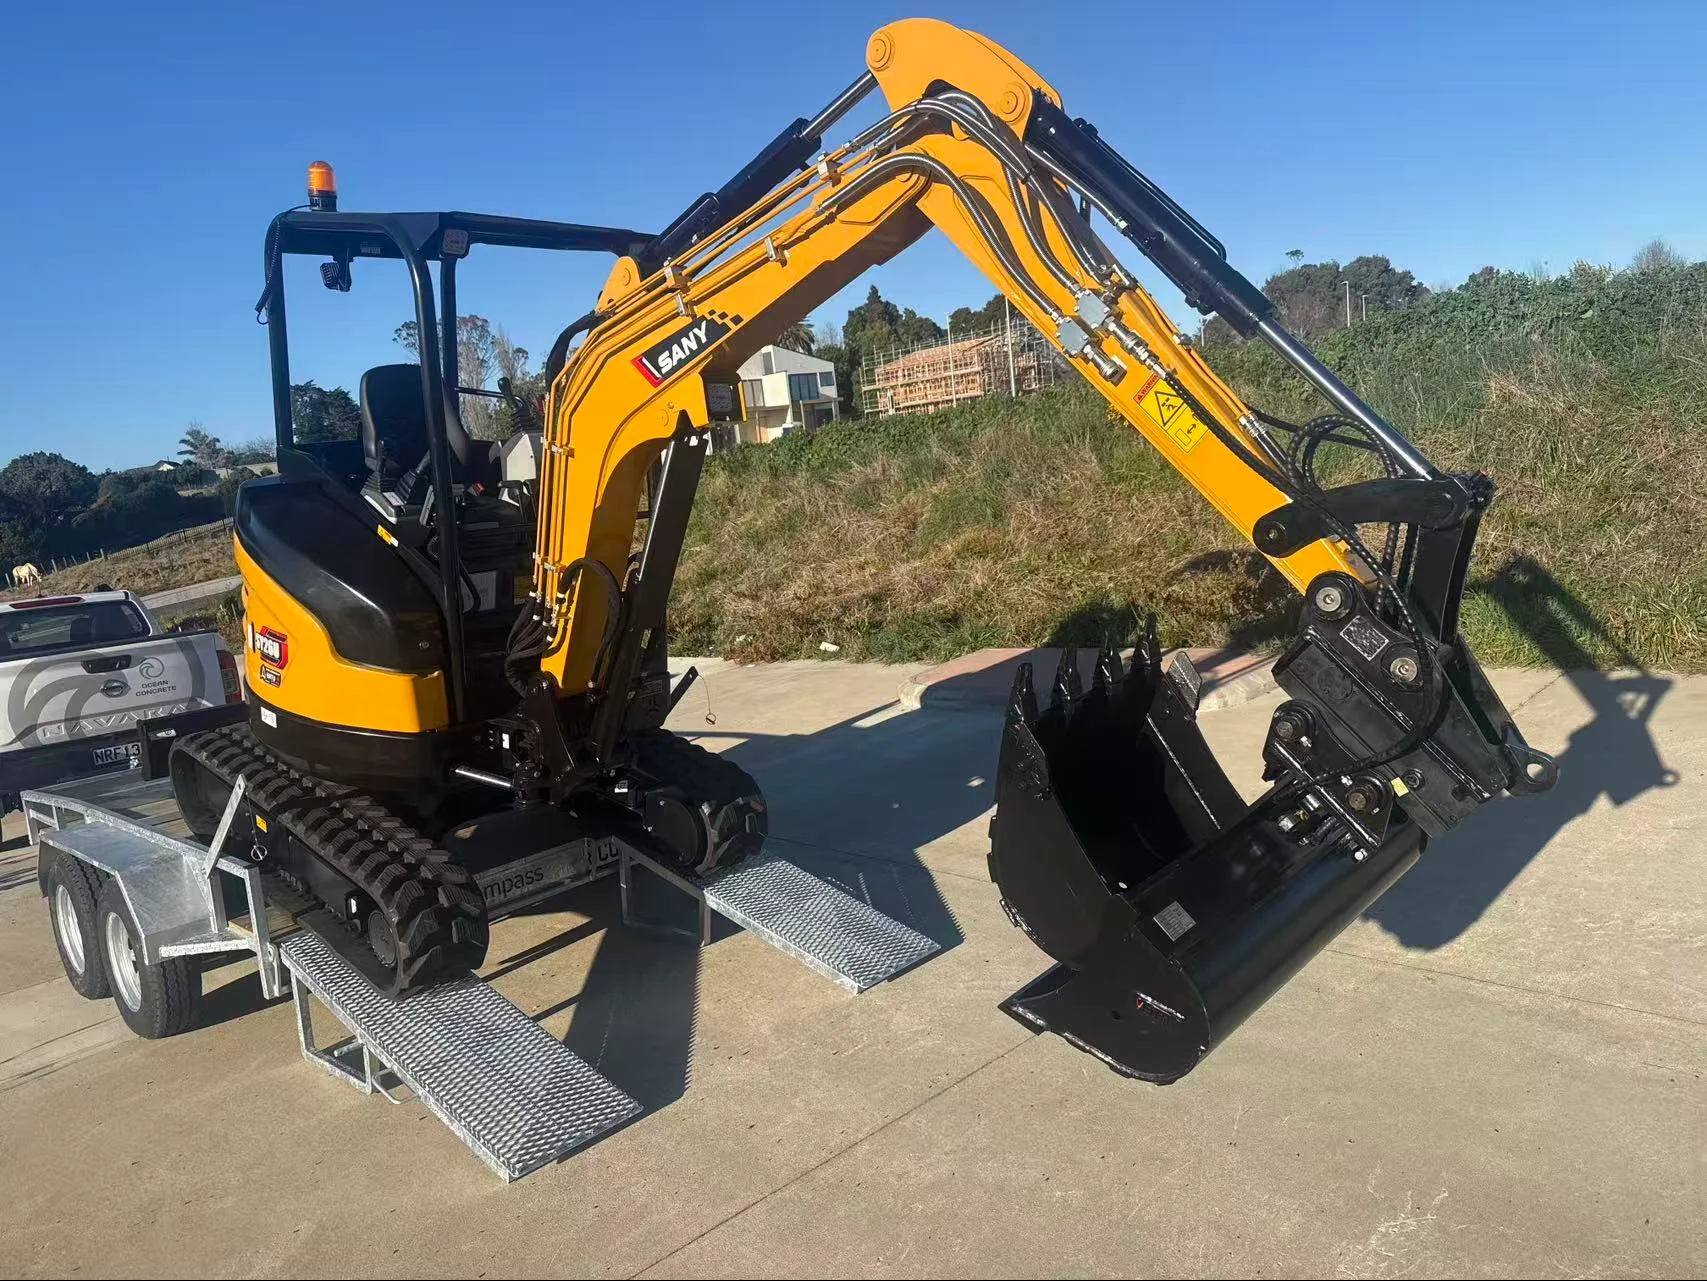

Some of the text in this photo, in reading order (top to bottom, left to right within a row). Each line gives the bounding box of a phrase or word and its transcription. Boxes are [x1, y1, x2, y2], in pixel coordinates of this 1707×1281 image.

[658, 320, 707, 375] SANY
[1140, 374, 1159, 396] WARNIN
[135, 685, 177, 697] CONCRETE
[141, 680, 169, 689] OCEAN
[42, 703, 187, 738] NAVARA
[94, 743, 141, 764] NRF13
[483, 867, 545, 900] mpass
